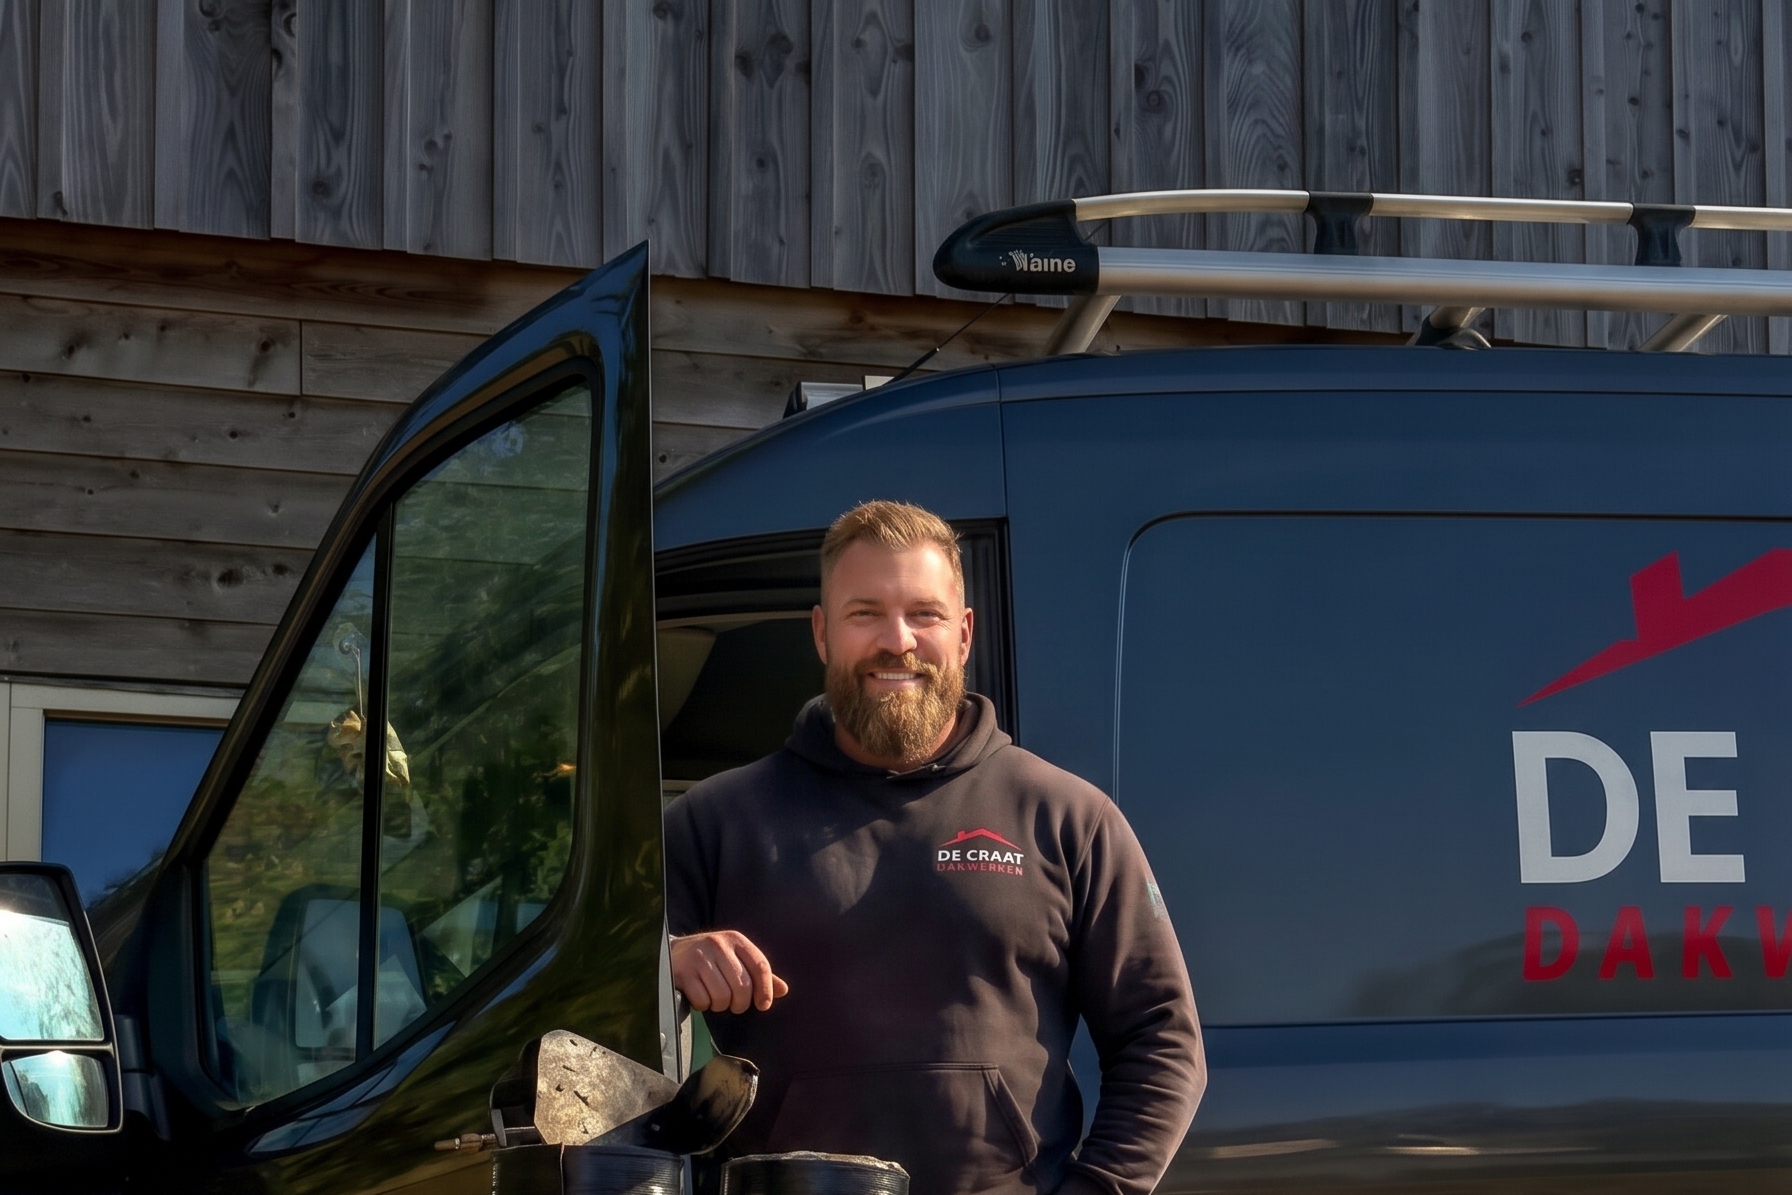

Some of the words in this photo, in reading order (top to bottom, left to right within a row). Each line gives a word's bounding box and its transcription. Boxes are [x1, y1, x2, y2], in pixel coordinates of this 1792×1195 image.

[1511, 730, 1746, 884] DE
[937, 850, 961, 862] DE
[966, 849, 1024, 865] CRAAT
[936, 862, 1023, 876] DAKWERKEN
